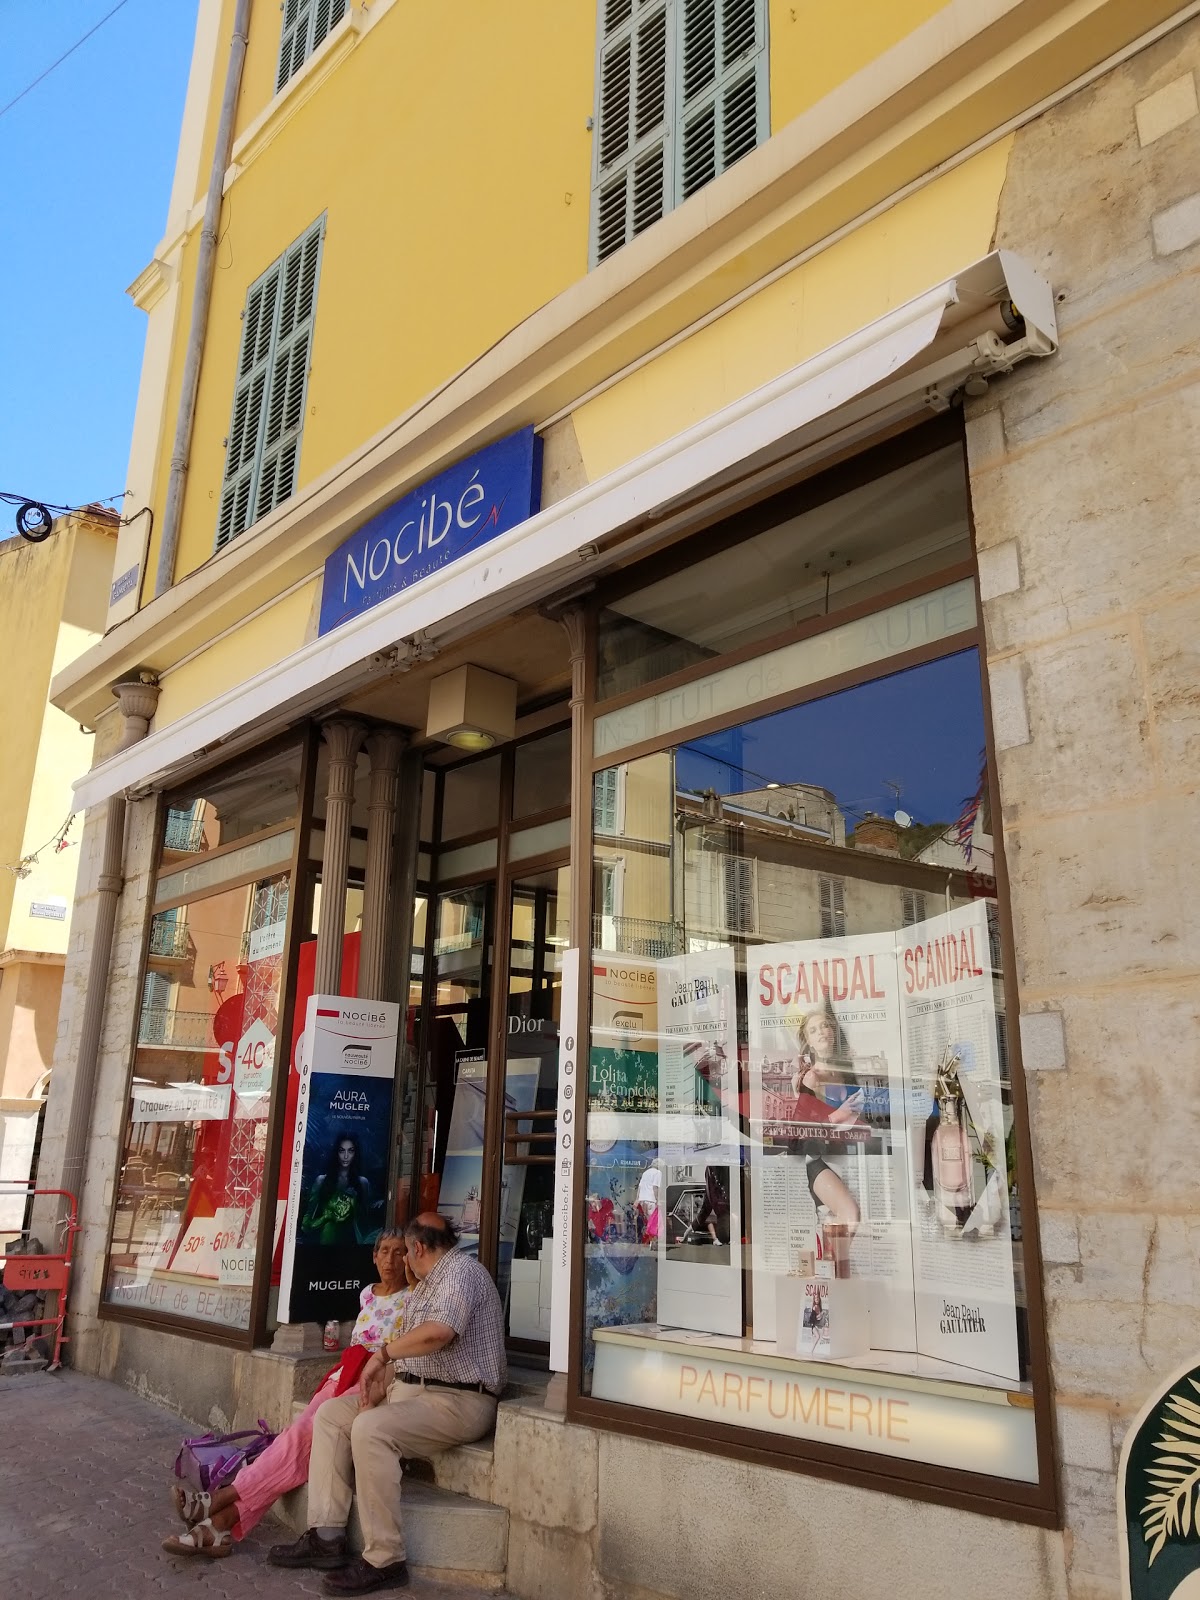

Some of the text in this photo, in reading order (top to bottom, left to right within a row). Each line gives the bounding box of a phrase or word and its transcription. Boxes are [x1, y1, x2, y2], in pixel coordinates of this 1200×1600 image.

[343, 469, 485, 603] Nocibé
[904, 927, 983, 994] SCANDAL
[675, 977, 714, 994] Jean Paul
[759, 954, 886, 1007] SCANDAL
[671, 983, 720, 1007] GAULTIER
[508, 1015, 545, 1034] Dior
[615, 1020, 637, 1029] exclu
[592, 1065, 627, 1083] Lolita
[334, 1090, 367, 1102] AURA
[329, 1102, 371, 1111] MUGLER
[183, 1236, 205, 1252] -50%
[308, 1280, 361, 1291] MUGLER
[174, 1289, 189, 1310] de
[942, 1299, 980, 1325] Jean Paul
[939, 1317, 986, 1335] GAULTIER
[678, 1364, 911, 1443] PARFUMERIE
